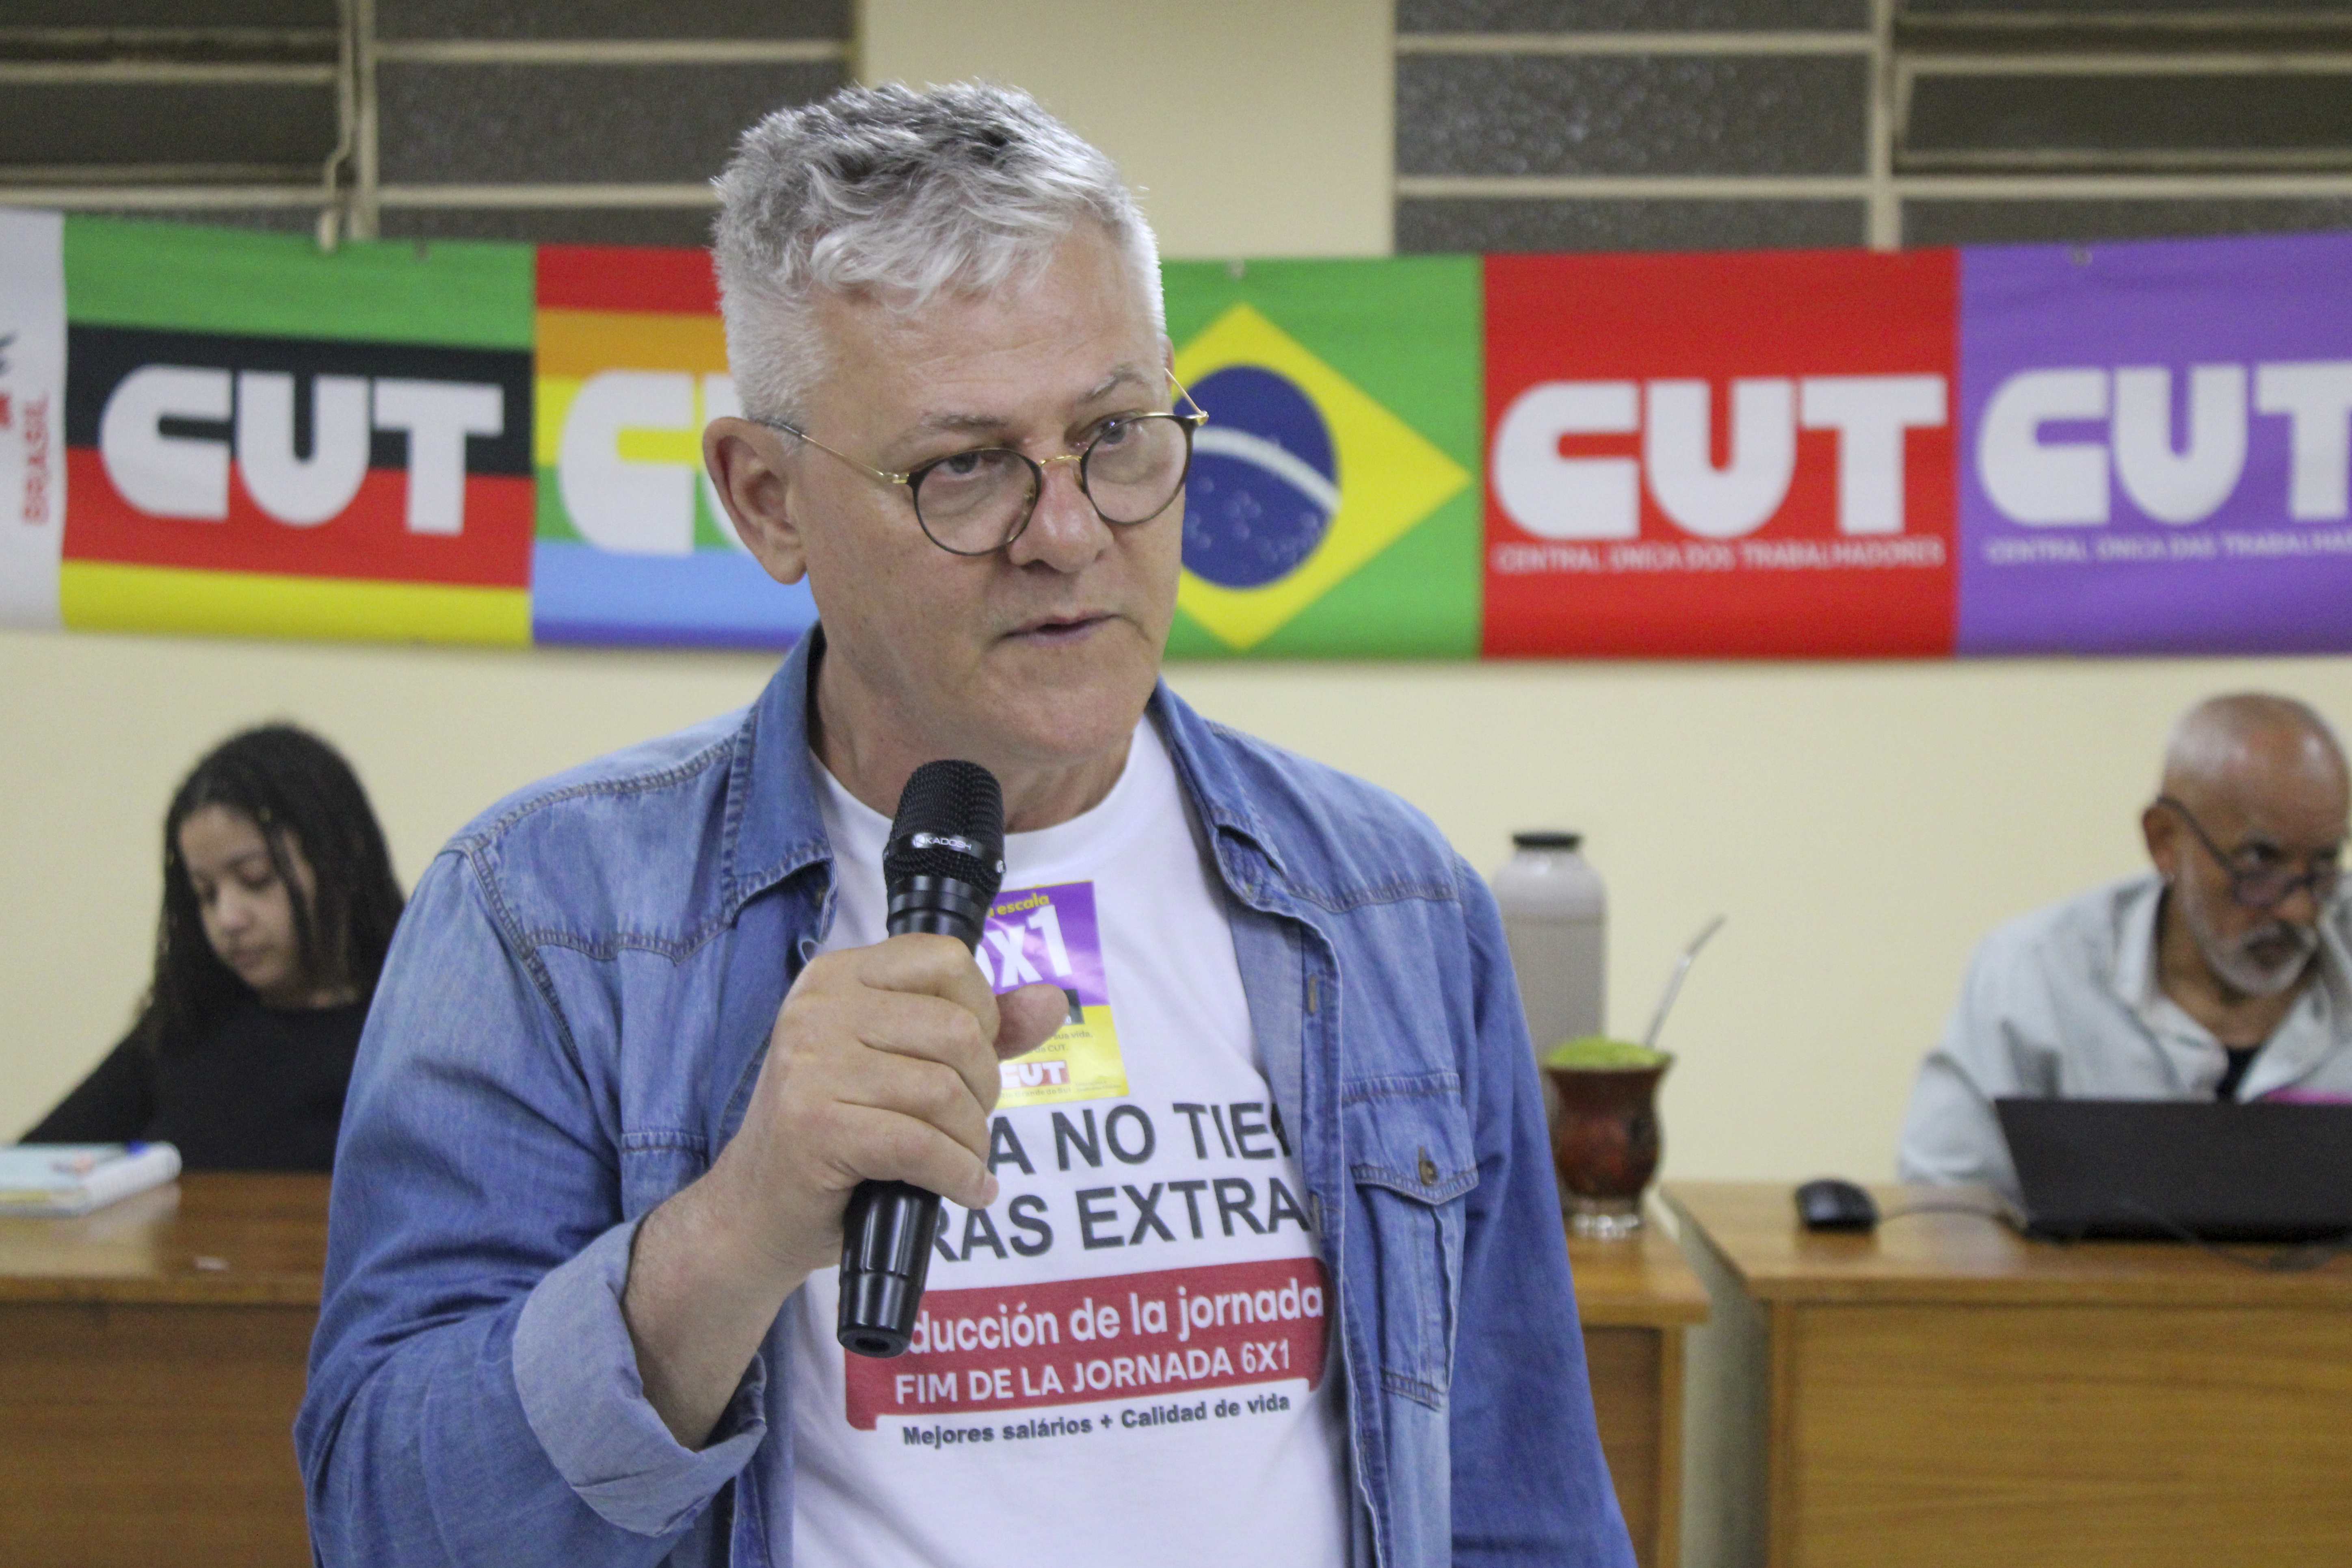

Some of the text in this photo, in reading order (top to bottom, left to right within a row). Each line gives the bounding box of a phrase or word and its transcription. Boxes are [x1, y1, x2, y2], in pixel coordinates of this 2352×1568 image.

[23, 395, 48, 524] BRASIL
[98, 363, 504, 535] CUT
[1492, 374, 1947, 539] CUT
[1976, 361, 2352, 526] CUT
[1495, 543, 1600, 573] CENTRAL
[925, 837, 972, 850] KADOSH
[996, 892, 1050, 915] escala
[1000, 1061, 1066, 1089] CUT
[1015, 1089, 1045, 1097] Grande
[1052, 1104, 1156, 1172] NO
[1075, 1177, 1311, 1250] EXTRA
[1069, 1297, 1121, 1341] de
[1129, 1292, 1168, 1335] la
[1178, 1277, 1324, 1342] jornada
[895, 1339, 1290, 1404] FIM DE LA JORNADA 6X1
[902, 1393, 1291, 1449] Mejores salários + Calidad de vida
